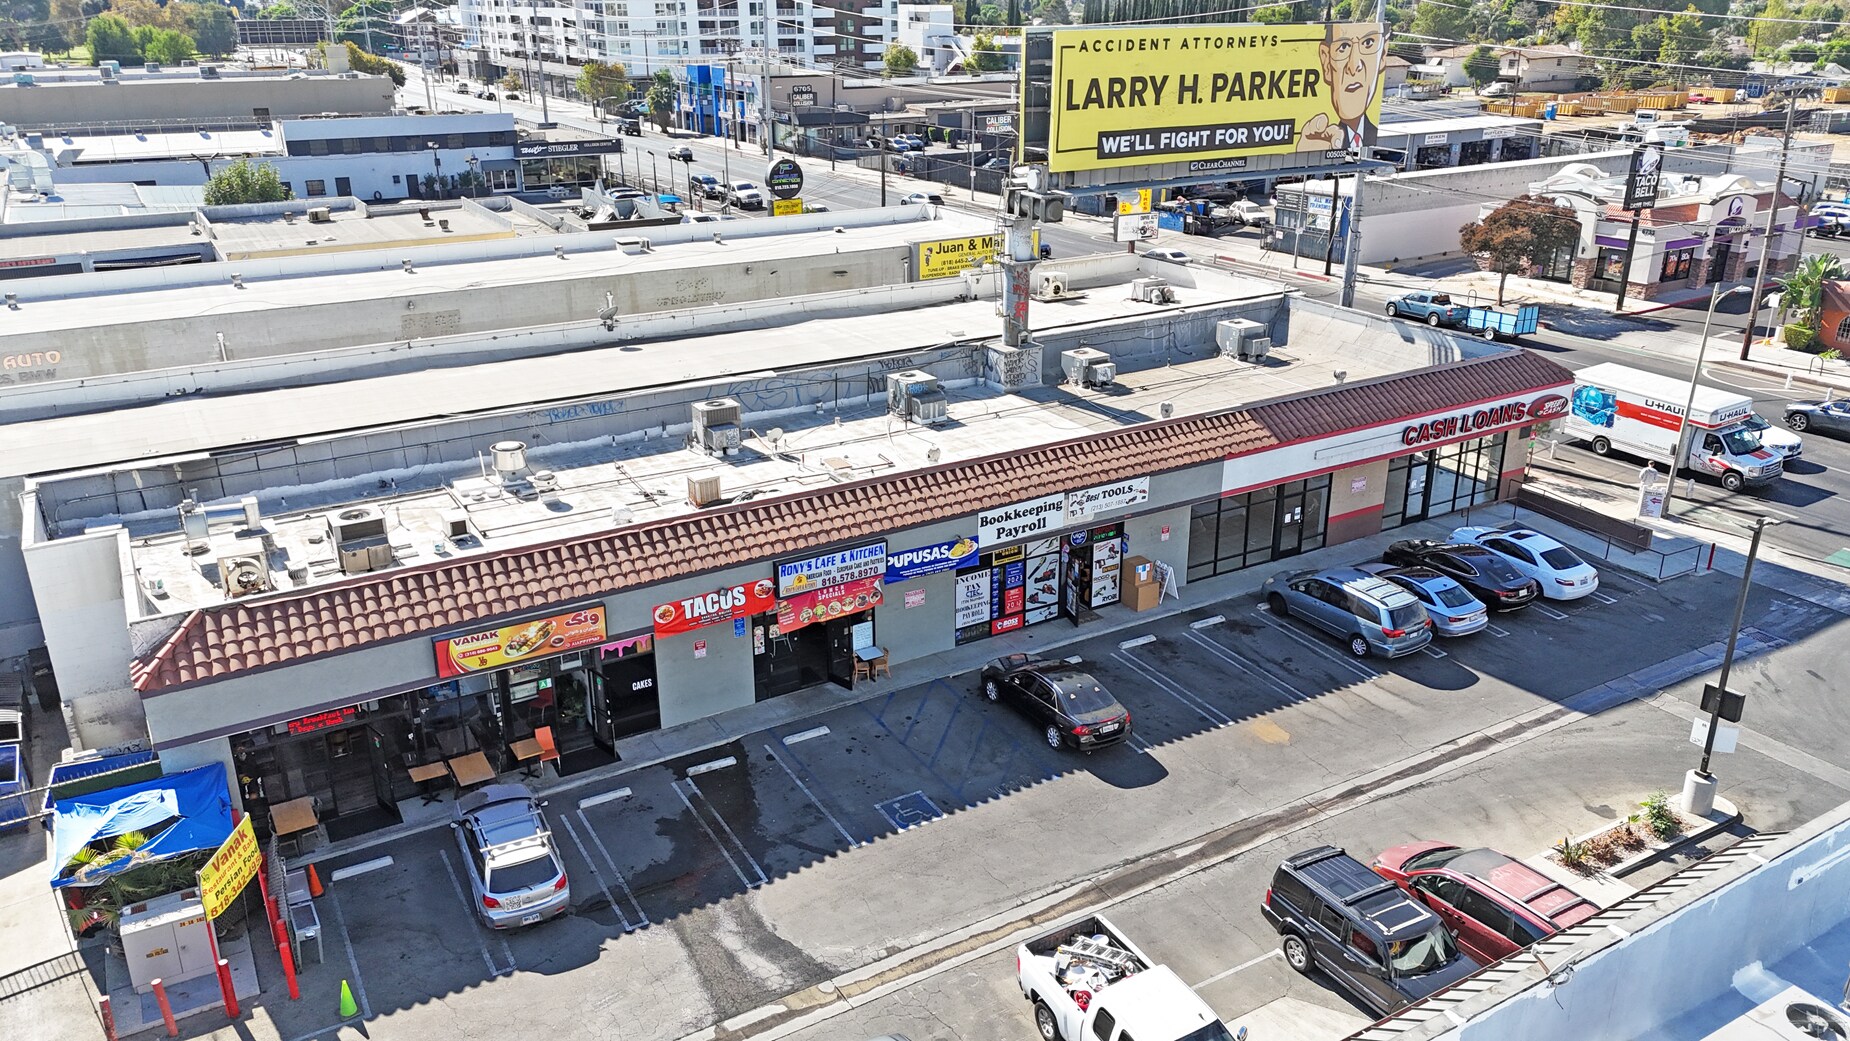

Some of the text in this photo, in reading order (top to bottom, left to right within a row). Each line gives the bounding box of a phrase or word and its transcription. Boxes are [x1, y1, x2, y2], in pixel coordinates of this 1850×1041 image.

[1079, 35, 1278, 53] ACCIDENT ATTORNEYS
[1066, 68, 1320, 111] LARRY H. PARKER
[986, 116, 1012, 125] CALIBER
[986, 125, 1012, 133] COLLISION
[1101, 123, 1291, 154] WE'LL FIGHT FOR YOU!
[548, 144, 579, 153] STIEGLER
[1635, 174, 1657, 187] TACO
[1634, 185, 1655, 198] BELL
[936, 236, 1004, 255] Juan & Mar
[3, 350, 61, 370] AUTO
[19, 368, 57, 382] BMW
[1644, 399, 1686, 415] U-HAUL
[1719, 407, 1748, 422] U-HAUL
[1404, 402, 1526, 446] CASH LOANS
[1101, 484, 1134, 500] TOOLS
[979, 500, 1063, 528] Bookkeeping
[996, 517, 1047, 540] Payroll
[780, 544, 885, 578] RONY'S CAFE & KITCHEN
[887, 545, 949, 568] PUPUSAS
[821, 565, 879, 587] 818.578.8970
[956, 570, 991, 585] INCOME
[818, 585, 845, 595] LUNCH
[818, 590, 845, 600] SPECIALS
[965, 582, 981, 591] TAX
[681, 586, 746, 620] TACOS
[564, 611, 600, 627] ونک
[453, 631, 499, 646] VANAK
[632, 678, 652, 691] CAKES
[211, 829, 248, 873] Vanak
[202, 859, 238, 897] Restaurant
[215, 846, 258, 901] Persian Food
[210, 855, 262, 918] 818-342-495
